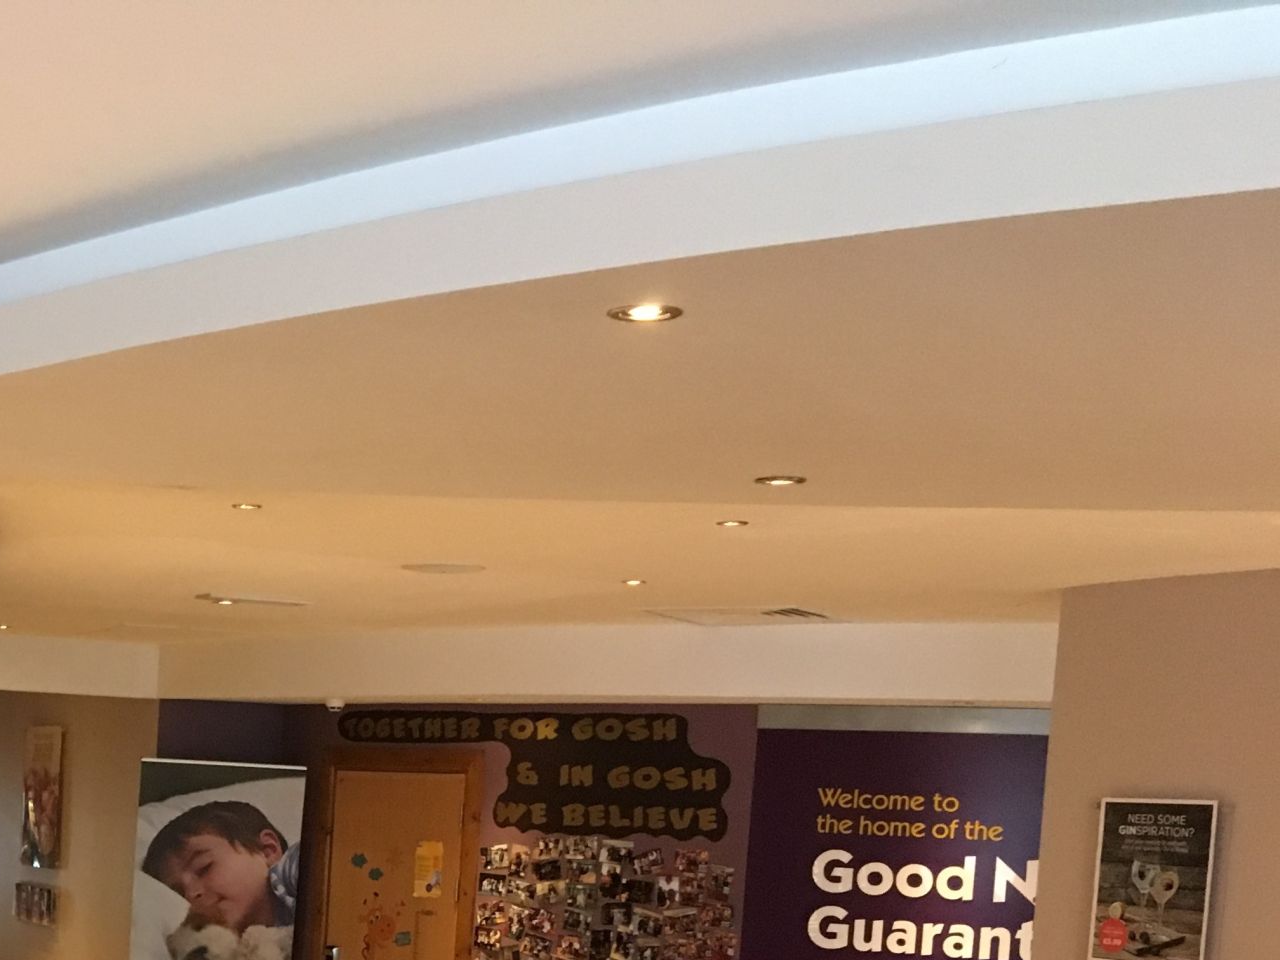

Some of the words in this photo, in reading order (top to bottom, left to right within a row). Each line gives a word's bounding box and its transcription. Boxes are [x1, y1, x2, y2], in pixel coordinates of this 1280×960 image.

[345, 717, 480, 739] TOGETHER
[493, 718, 559, 741] FOR
[572, 717, 677, 741] GOSH
[517, 761, 538, 786] &
[560, 764, 593, 787] IN
[607, 766, 716, 791] GOSH
[818, 788, 925, 811] Welcome
[933, 793, 960, 812] to
[495, 801, 547, 825] WE
[562, 803, 718, 831] BELIEVE
[817, 814, 854, 834] the
[859, 816, 925, 838] home
[932, 819, 959, 839] of
[964, 821, 1004, 842] the
[1128, 814, 1154, 825] NEED
[1157, 814, 1187, 826] SOME
[1118, 825, 1195, 838] GINSPIRATION?
[812, 849, 976, 901] Good
